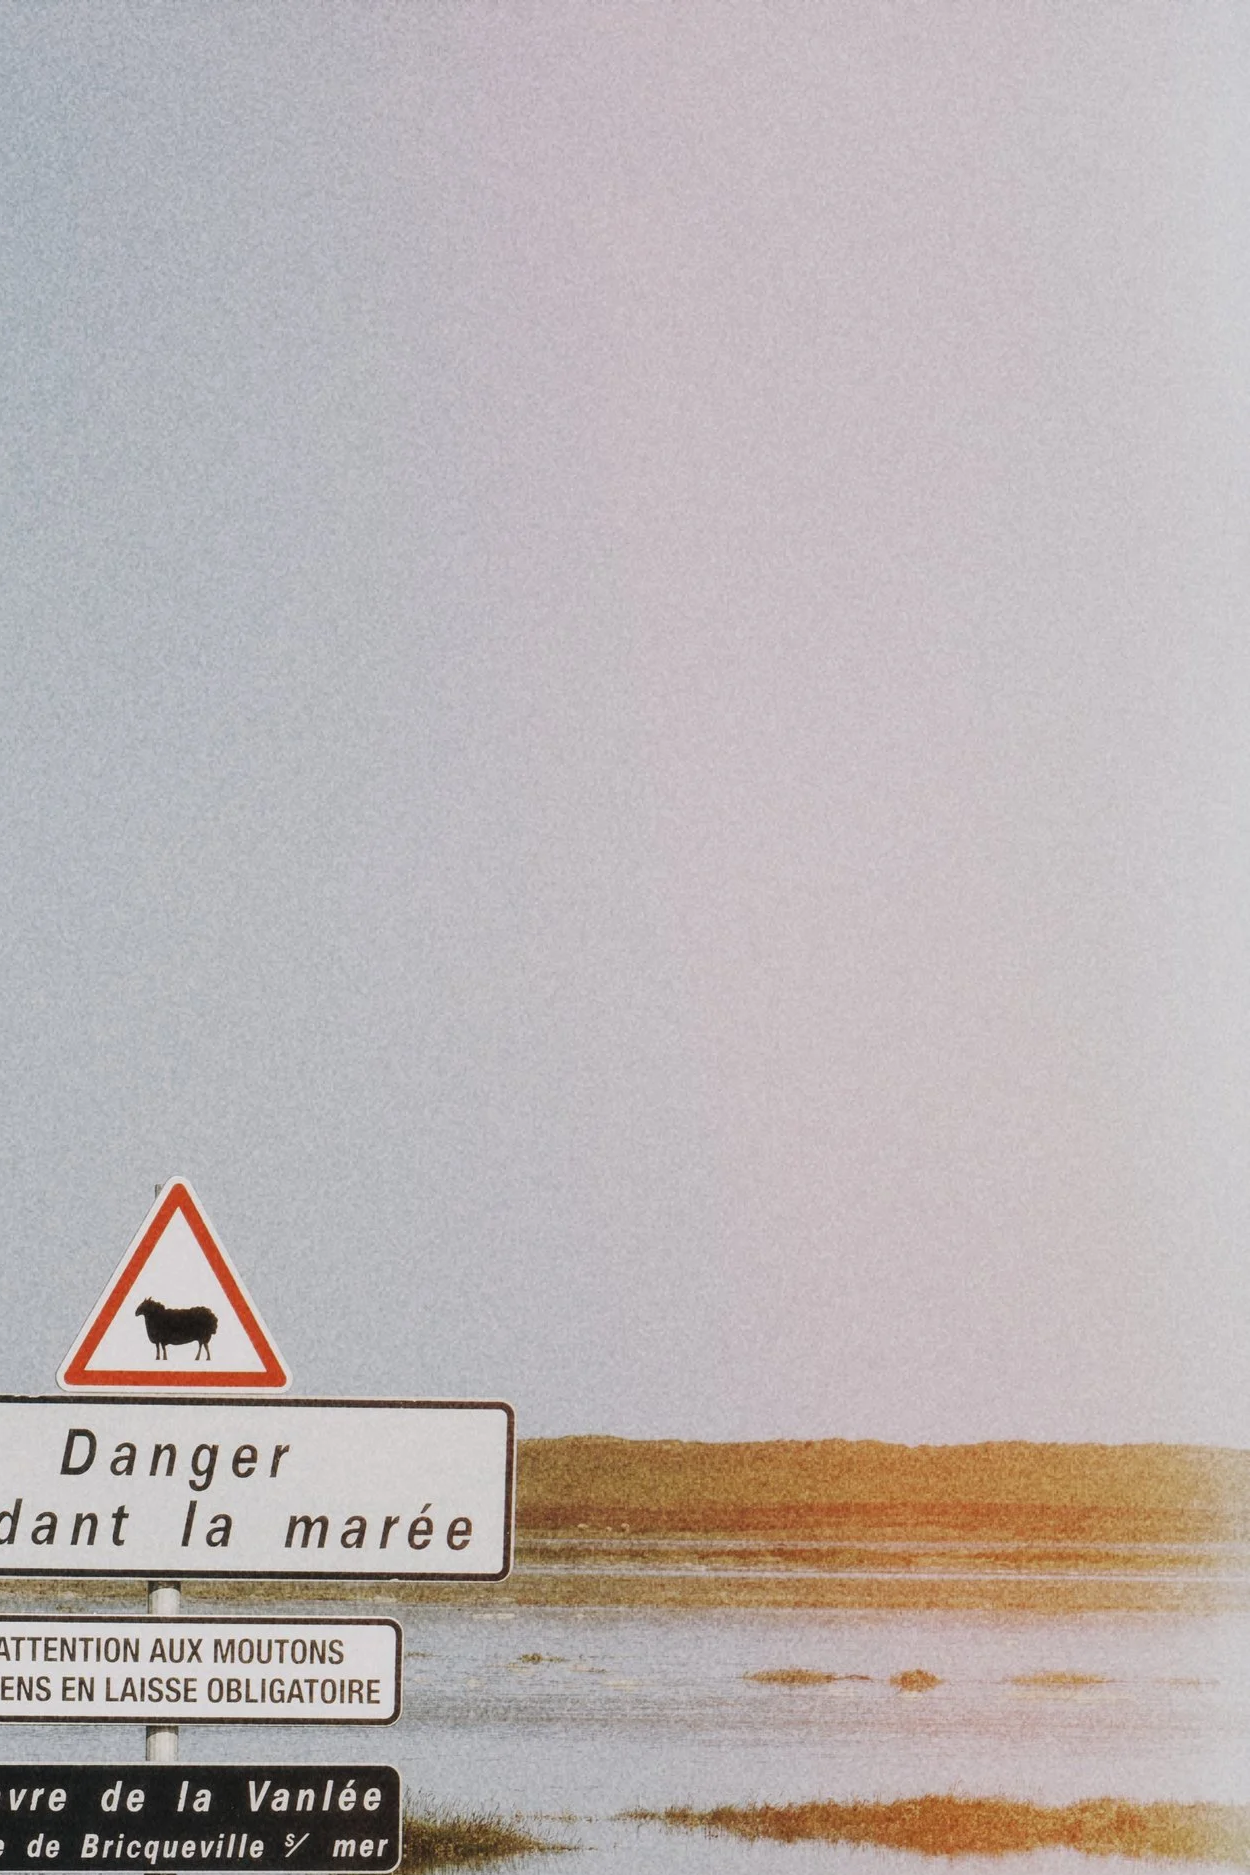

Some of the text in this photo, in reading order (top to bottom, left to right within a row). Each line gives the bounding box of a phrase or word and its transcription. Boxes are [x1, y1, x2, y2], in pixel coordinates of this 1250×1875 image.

[61, 1429, 289, 1491] Danger
[182, 1501, 232, 1547] la
[285, 1504, 472, 1550] marée
[150, 1638, 202, 1663] AUX
[214, 1639, 343, 1664] MOUTONS
[62, 1677, 94, 1701] EN
[106, 1678, 197, 1702] LAISSE
[208, 1678, 380, 1704] OBLIGATOIRE
[101, 1781, 144, 1812] de
[178, 1781, 211, 1812] la
[249, 1780, 381, 1811] Vanlée
[27, 1834, 59, 1858] de
[81, 1834, 263, 1864] Bricqueville
[285, 1833, 309, 1857] s/
[333, 1839, 388, 1857] mer
